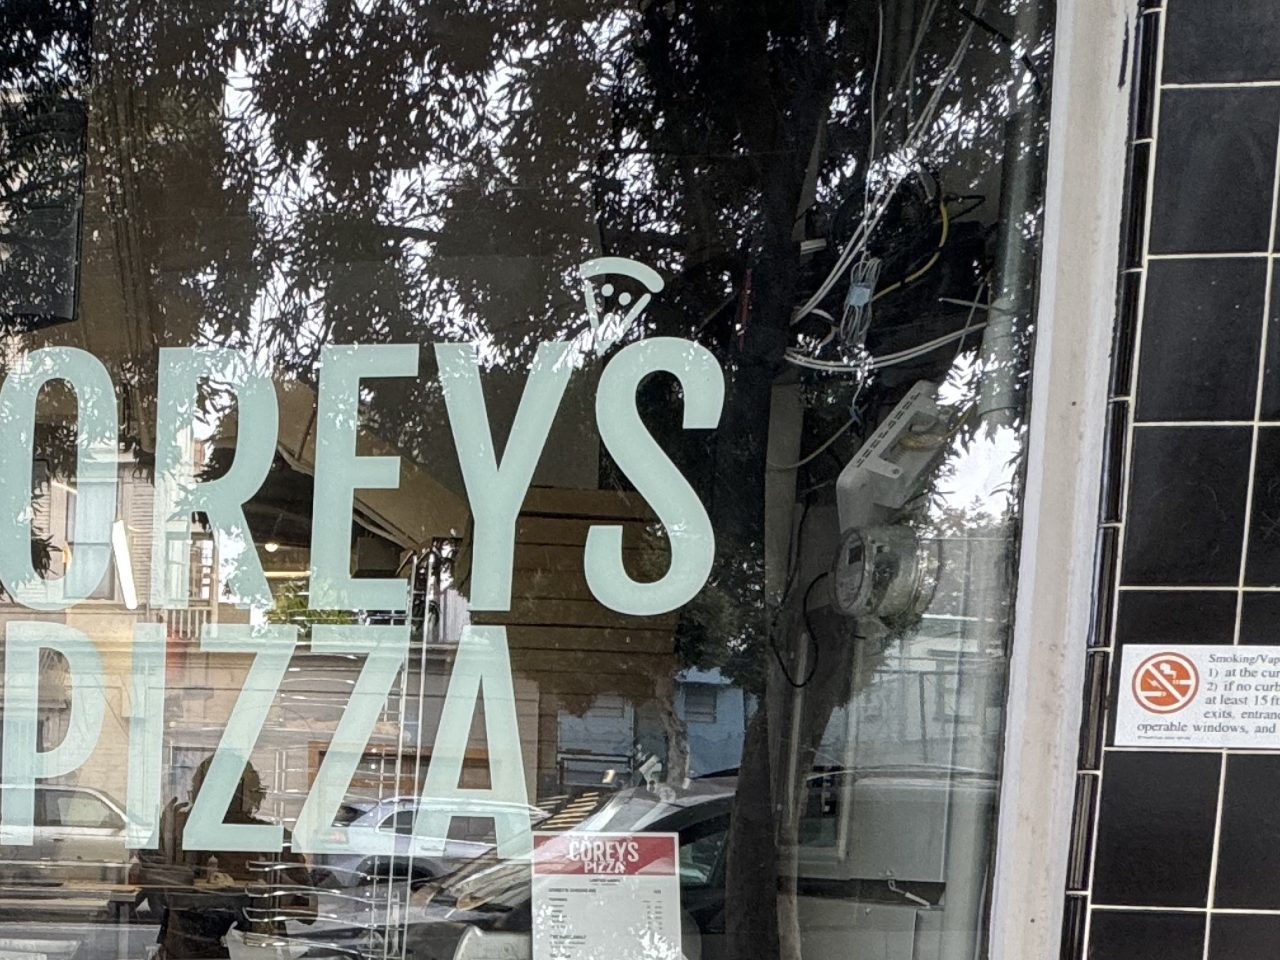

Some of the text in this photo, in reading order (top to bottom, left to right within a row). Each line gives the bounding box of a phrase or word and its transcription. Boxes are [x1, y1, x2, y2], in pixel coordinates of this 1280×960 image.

[1208, 668, 1219, 679] 1)
[1224, 669, 1236, 678] at
[1239, 667, 1258, 678] the
[1206, 681, 1218, 691] 2)
[1224, 680, 1236, 691] if
[1236, 683, 1252, 691] no
[1205, 696, 1217, 704] at
[1220, 694, 1248, 705] least
[1254, 695, 1269, 706] 15
[1137, 722, 1276, 734] operable windows, and
[0, 621, 540, 859] PIZZA
[569, 841, 639, 862] COREYS
[583, 861, 626, 874] PIZZA
